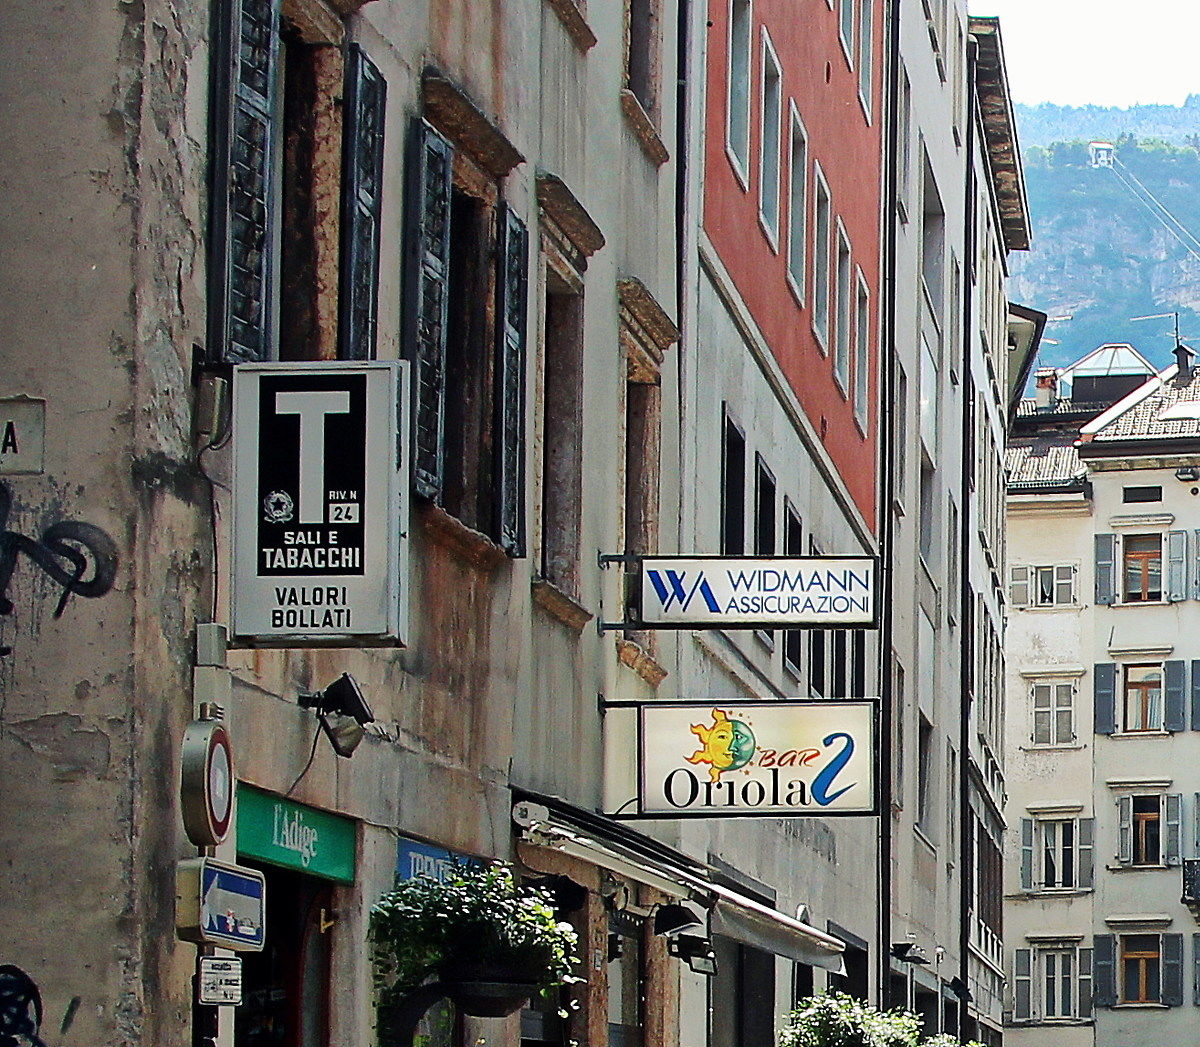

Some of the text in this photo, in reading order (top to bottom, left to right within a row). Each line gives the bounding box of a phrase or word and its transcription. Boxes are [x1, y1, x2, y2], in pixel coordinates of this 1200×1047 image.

[275, 391, 350, 524] T
[333, 506, 353, 521] 24
[284, 531, 338, 545] SALI E
[262, 548, 360, 568] TABACCHI
[726, 570, 870, 592] WIDMANN
[275, 586, 347, 606] VALORI
[724, 595, 870, 614] ASSICURAZIONI
[271, 609, 351, 628] BOLLATI
[757, 748, 821, 768] BAR
[663, 732, 858, 809] Oriola 2
